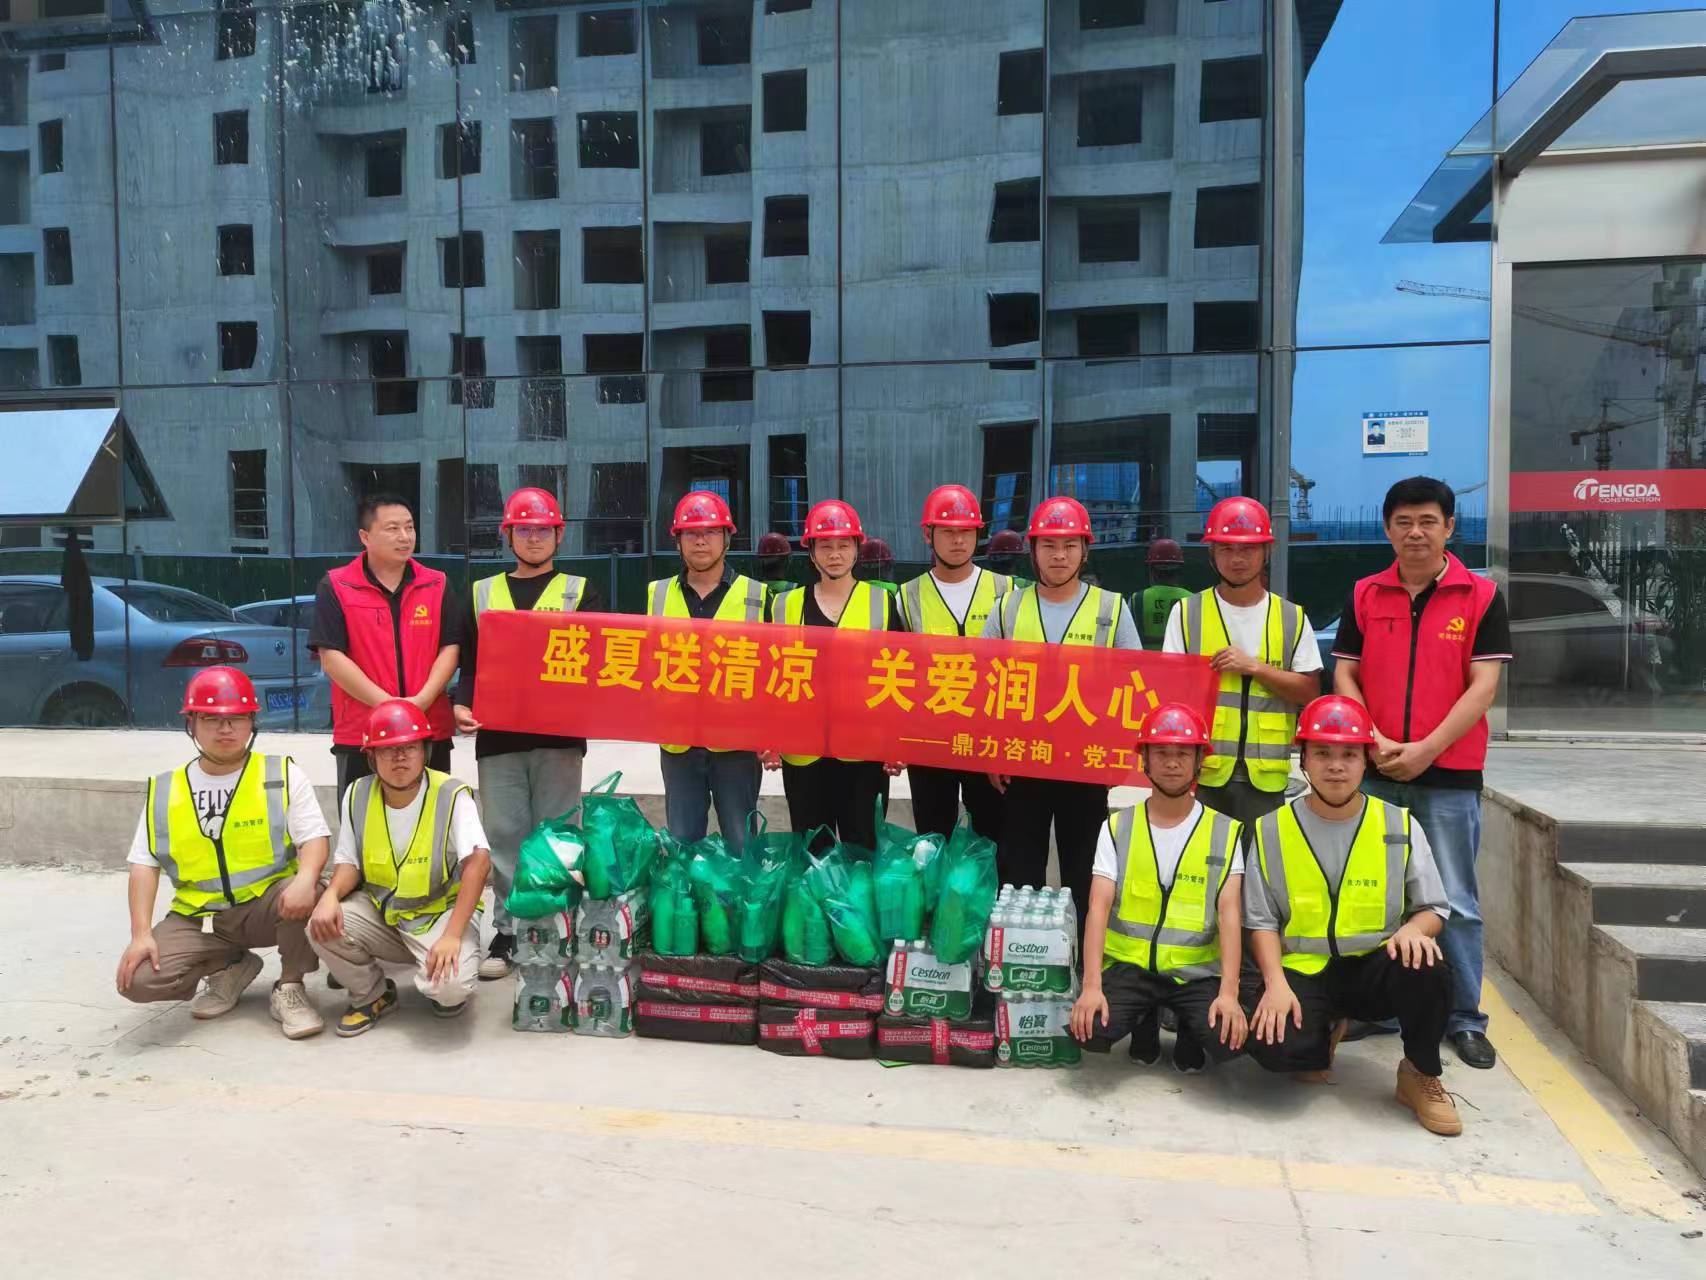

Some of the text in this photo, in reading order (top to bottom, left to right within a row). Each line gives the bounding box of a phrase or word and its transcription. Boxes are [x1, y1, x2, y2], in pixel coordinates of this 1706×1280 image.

[540, 624, 1160, 730] 盛夏送清凉 关爱润人心
